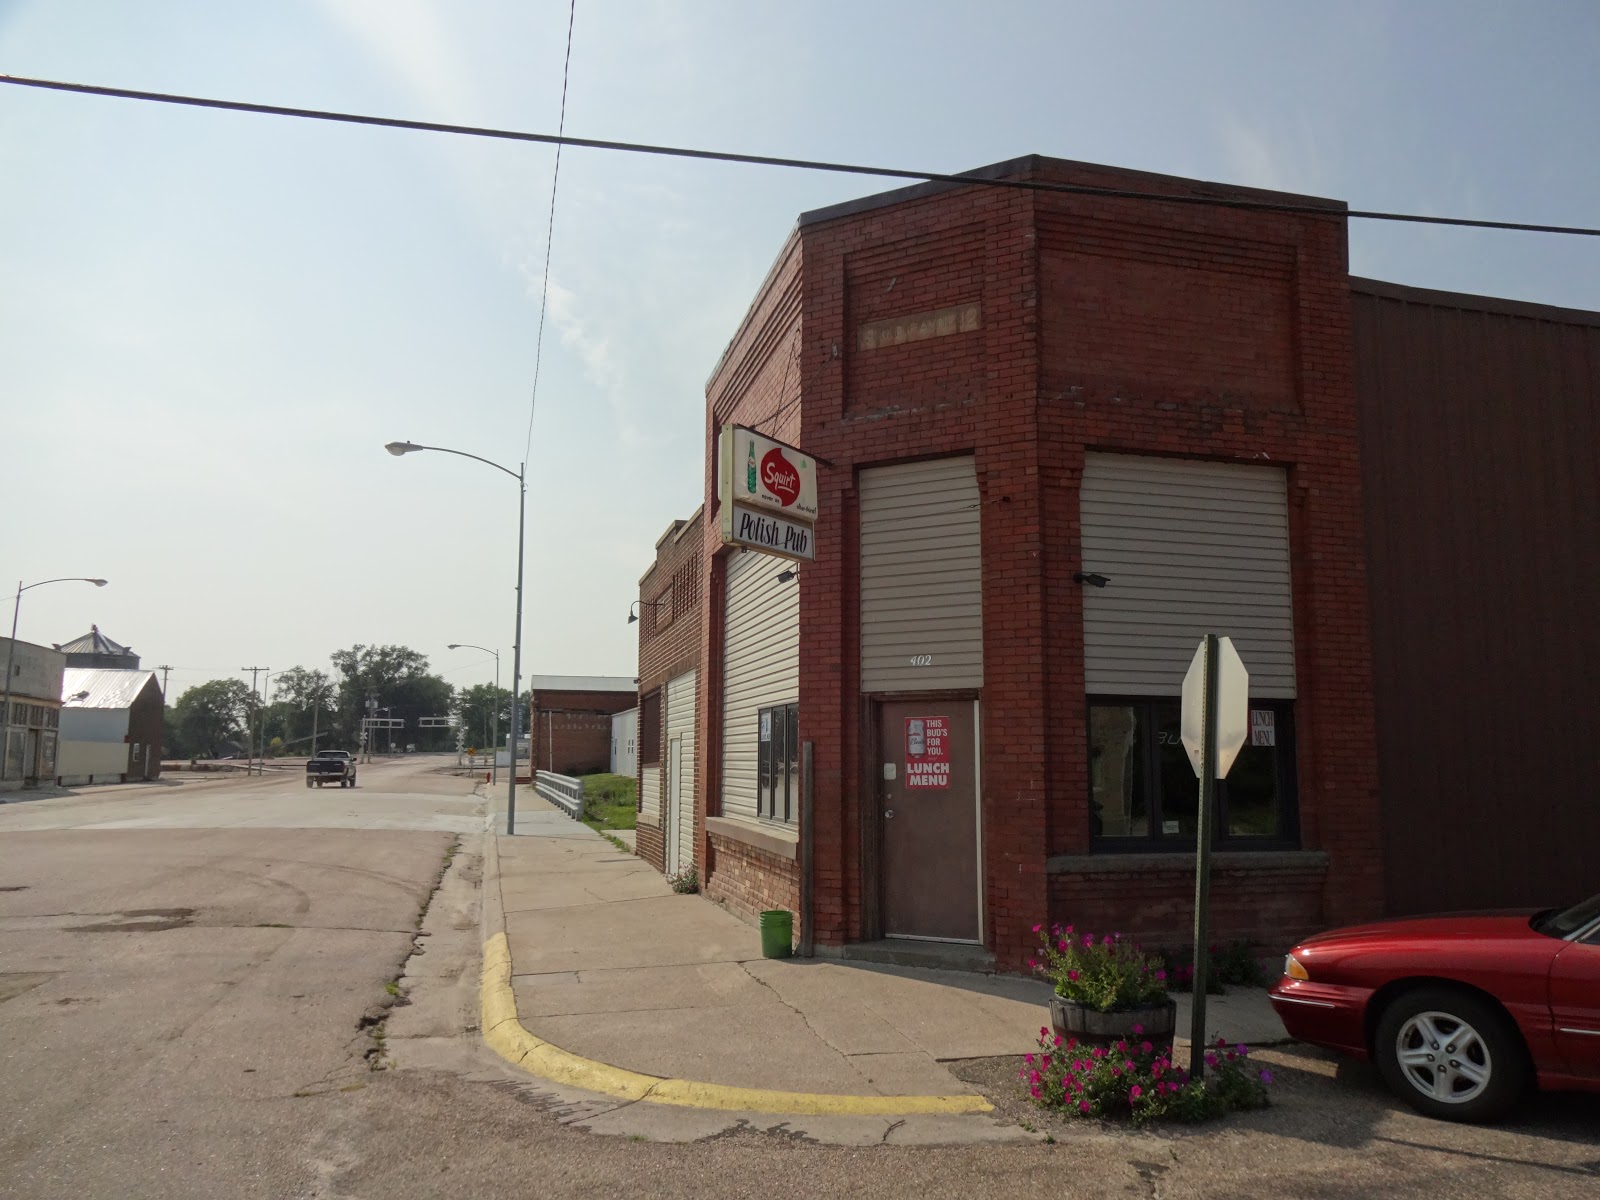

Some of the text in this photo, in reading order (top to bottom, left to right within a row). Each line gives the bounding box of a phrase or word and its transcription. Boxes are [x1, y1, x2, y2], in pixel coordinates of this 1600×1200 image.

[764, 461, 796, 491] Squirt
[739, 512, 808, 554] Polish Pub
[910, 654, 932, 667] 402
[926, 719, 942, 728] THIS
[1252, 711, 1274, 727] LUNCH
[926, 728, 948, 737] BUD'S
[1254, 730, 1273, 746] MENU
[927, 738, 941, 746] FOR
[927, 747, 944, 756] YOU.
[907, 762, 950, 774] LUNCH
[909, 774, 948, 786] MENU
